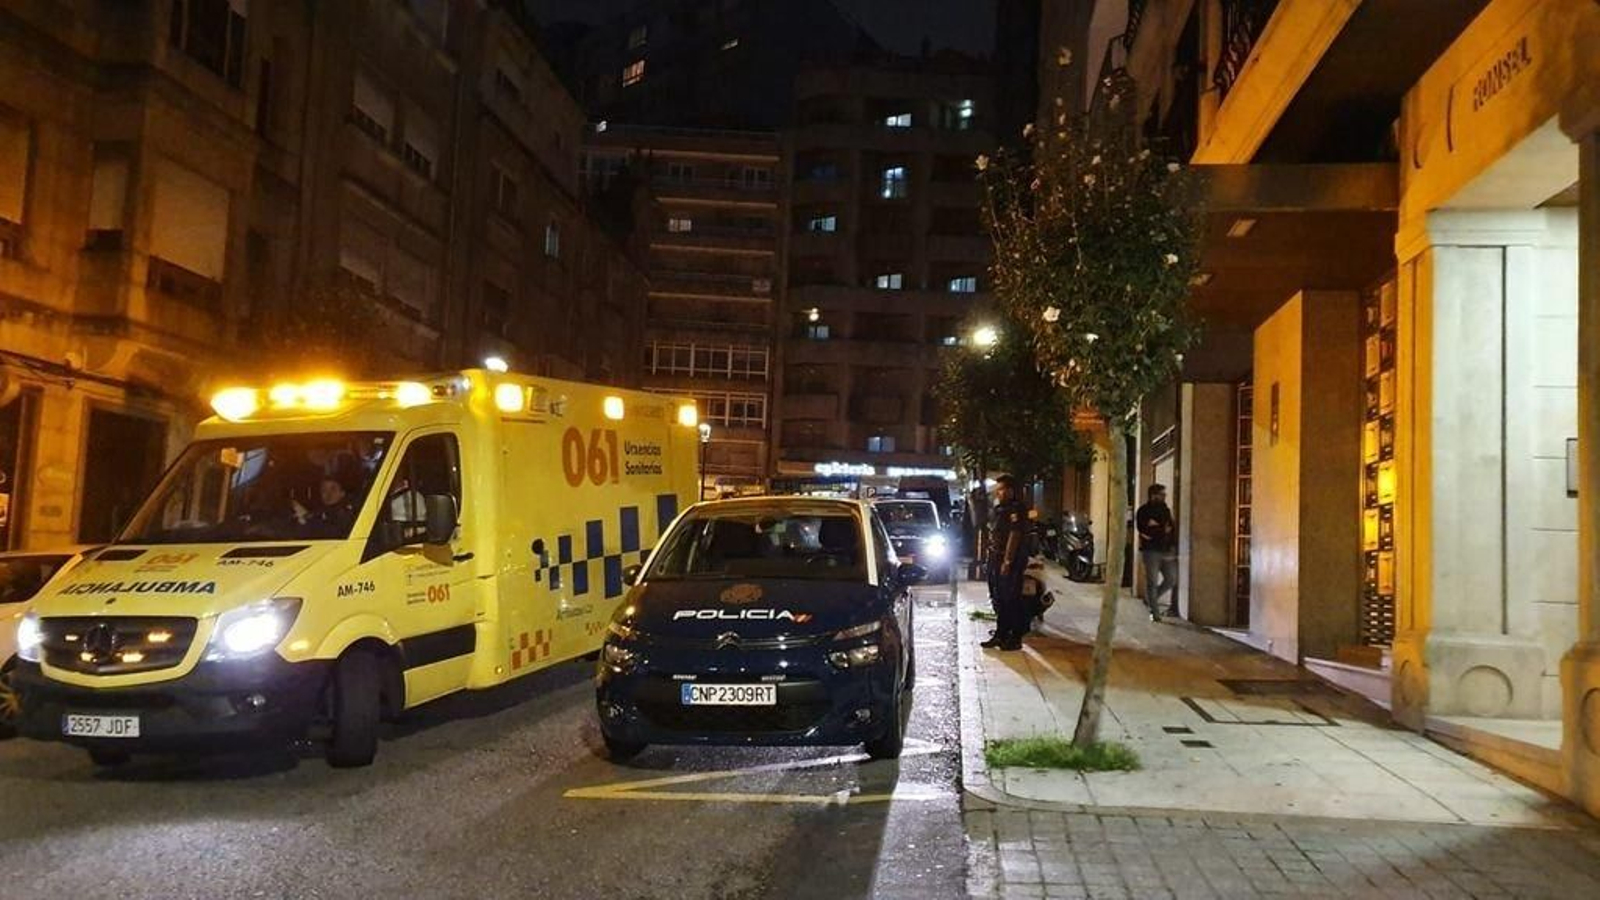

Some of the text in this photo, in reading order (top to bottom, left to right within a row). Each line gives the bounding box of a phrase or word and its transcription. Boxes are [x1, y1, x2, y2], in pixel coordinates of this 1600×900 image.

[624, 440, 662, 456] Urxencias
[562, 426, 619, 487] 061
[624, 460, 663, 476] Sanitarias
[217, 559, 276, 568] AM-746
[337, 580, 376, 598] AM-746
[427, 583, 451, 604] 061
[673, 608, 796, 621] POLICIA
[70, 717, 101, 733] 2557
